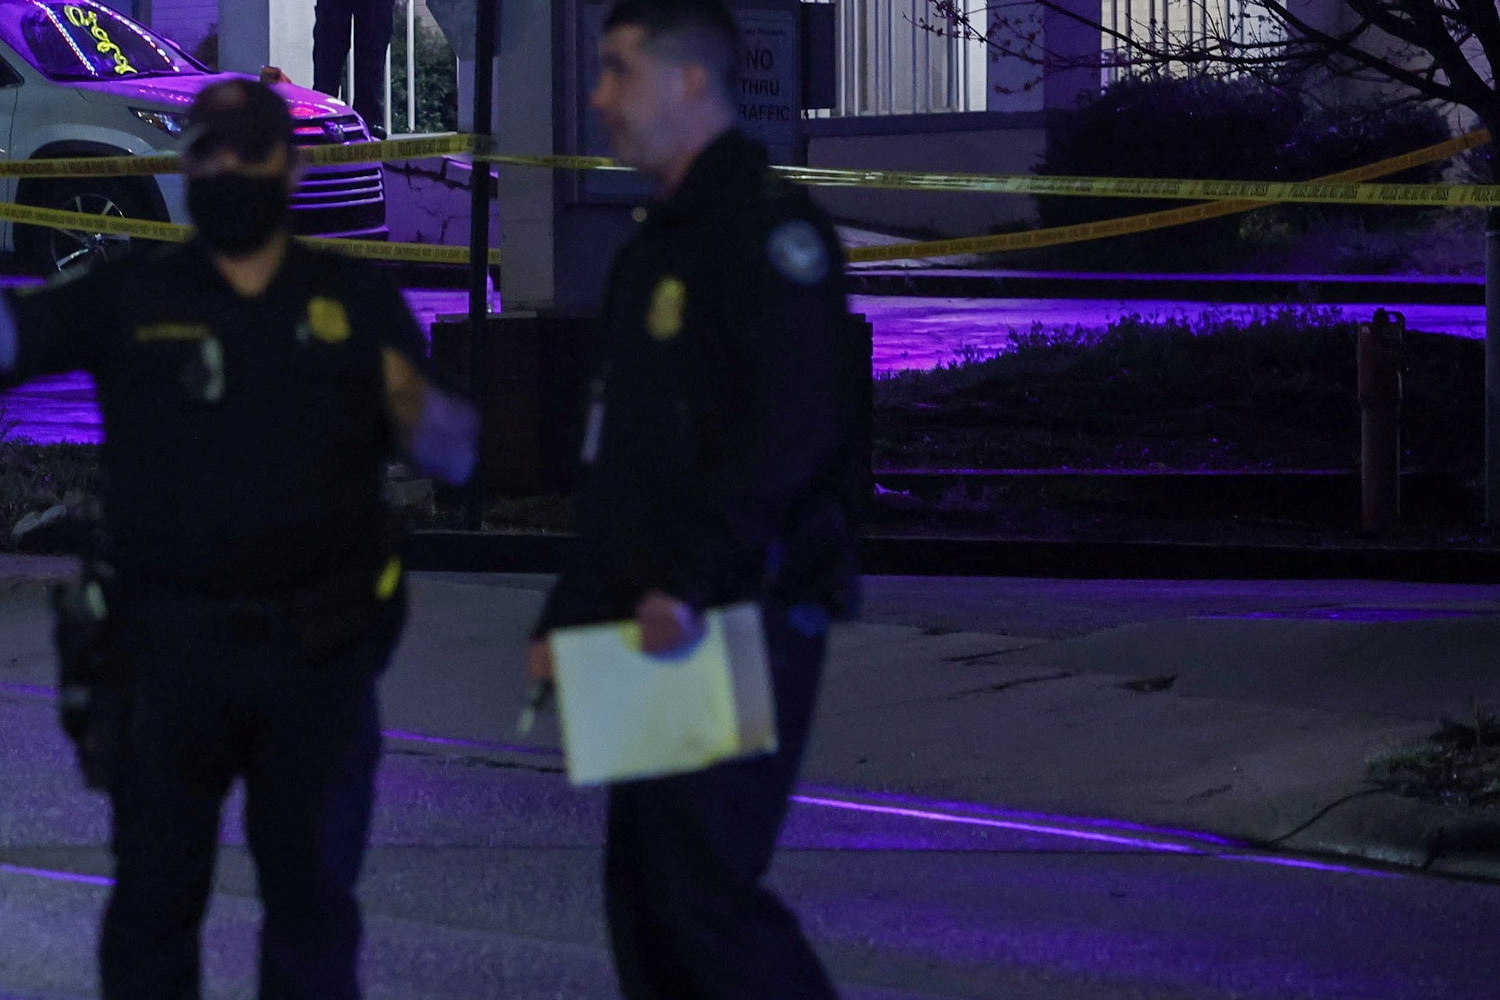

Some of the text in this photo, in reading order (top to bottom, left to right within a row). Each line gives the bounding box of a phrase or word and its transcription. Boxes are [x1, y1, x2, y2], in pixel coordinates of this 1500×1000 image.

[746, 48, 774, 71] NO
[740, 79, 780, 97] THRU
[735, 103, 790, 122] RAFFIC
